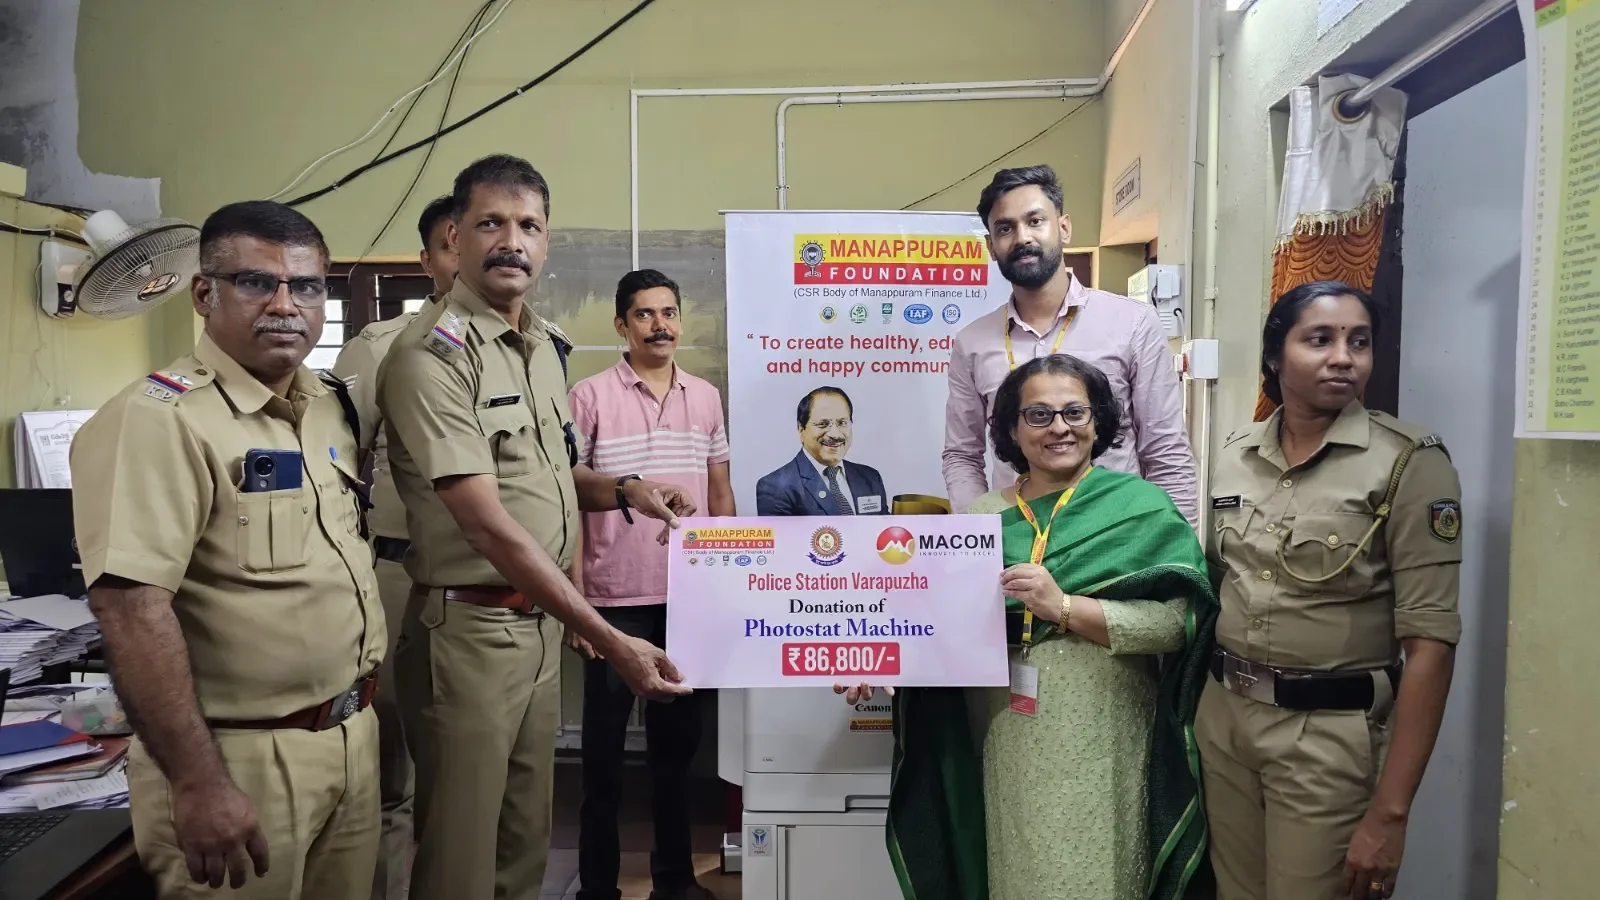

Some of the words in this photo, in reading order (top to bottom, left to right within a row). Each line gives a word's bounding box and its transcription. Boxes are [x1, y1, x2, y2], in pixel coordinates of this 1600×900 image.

[829, 239, 983, 259] MANAPPURAM
[829, 266, 982, 282] FOUNDATION
[793, 287, 820, 298] (CSR
[823, 287, 847, 299] Body
[849, 287, 859, 297] of
[860, 288, 923, 299] Manappuram
[925, 288, 963, 299] Finance
[965, 289, 988, 299] Ltd.)
[760, 336, 781, 350] To
[786, 336, 844, 350] create
[850, 334, 923, 354] healthy,
[928, 335, 955, 350] ed
[767, 359, 802, 373] and
[808, 358, 865, 377] happy
[699, 529, 772, 538] MANAPPURAM
[919, 534, 995, 550] MACOM
[748, 573, 792, 591] Police
[795, 572, 848, 591] Station
[851, 572, 929, 593] Varapuzha
[788, 599, 865, 614] Donation
[868, 598, 887, 613] of
[744, 618, 841, 638] Photostat
[845, 618, 935, 637] Machine
[855, 703, 892, 713] Canon
